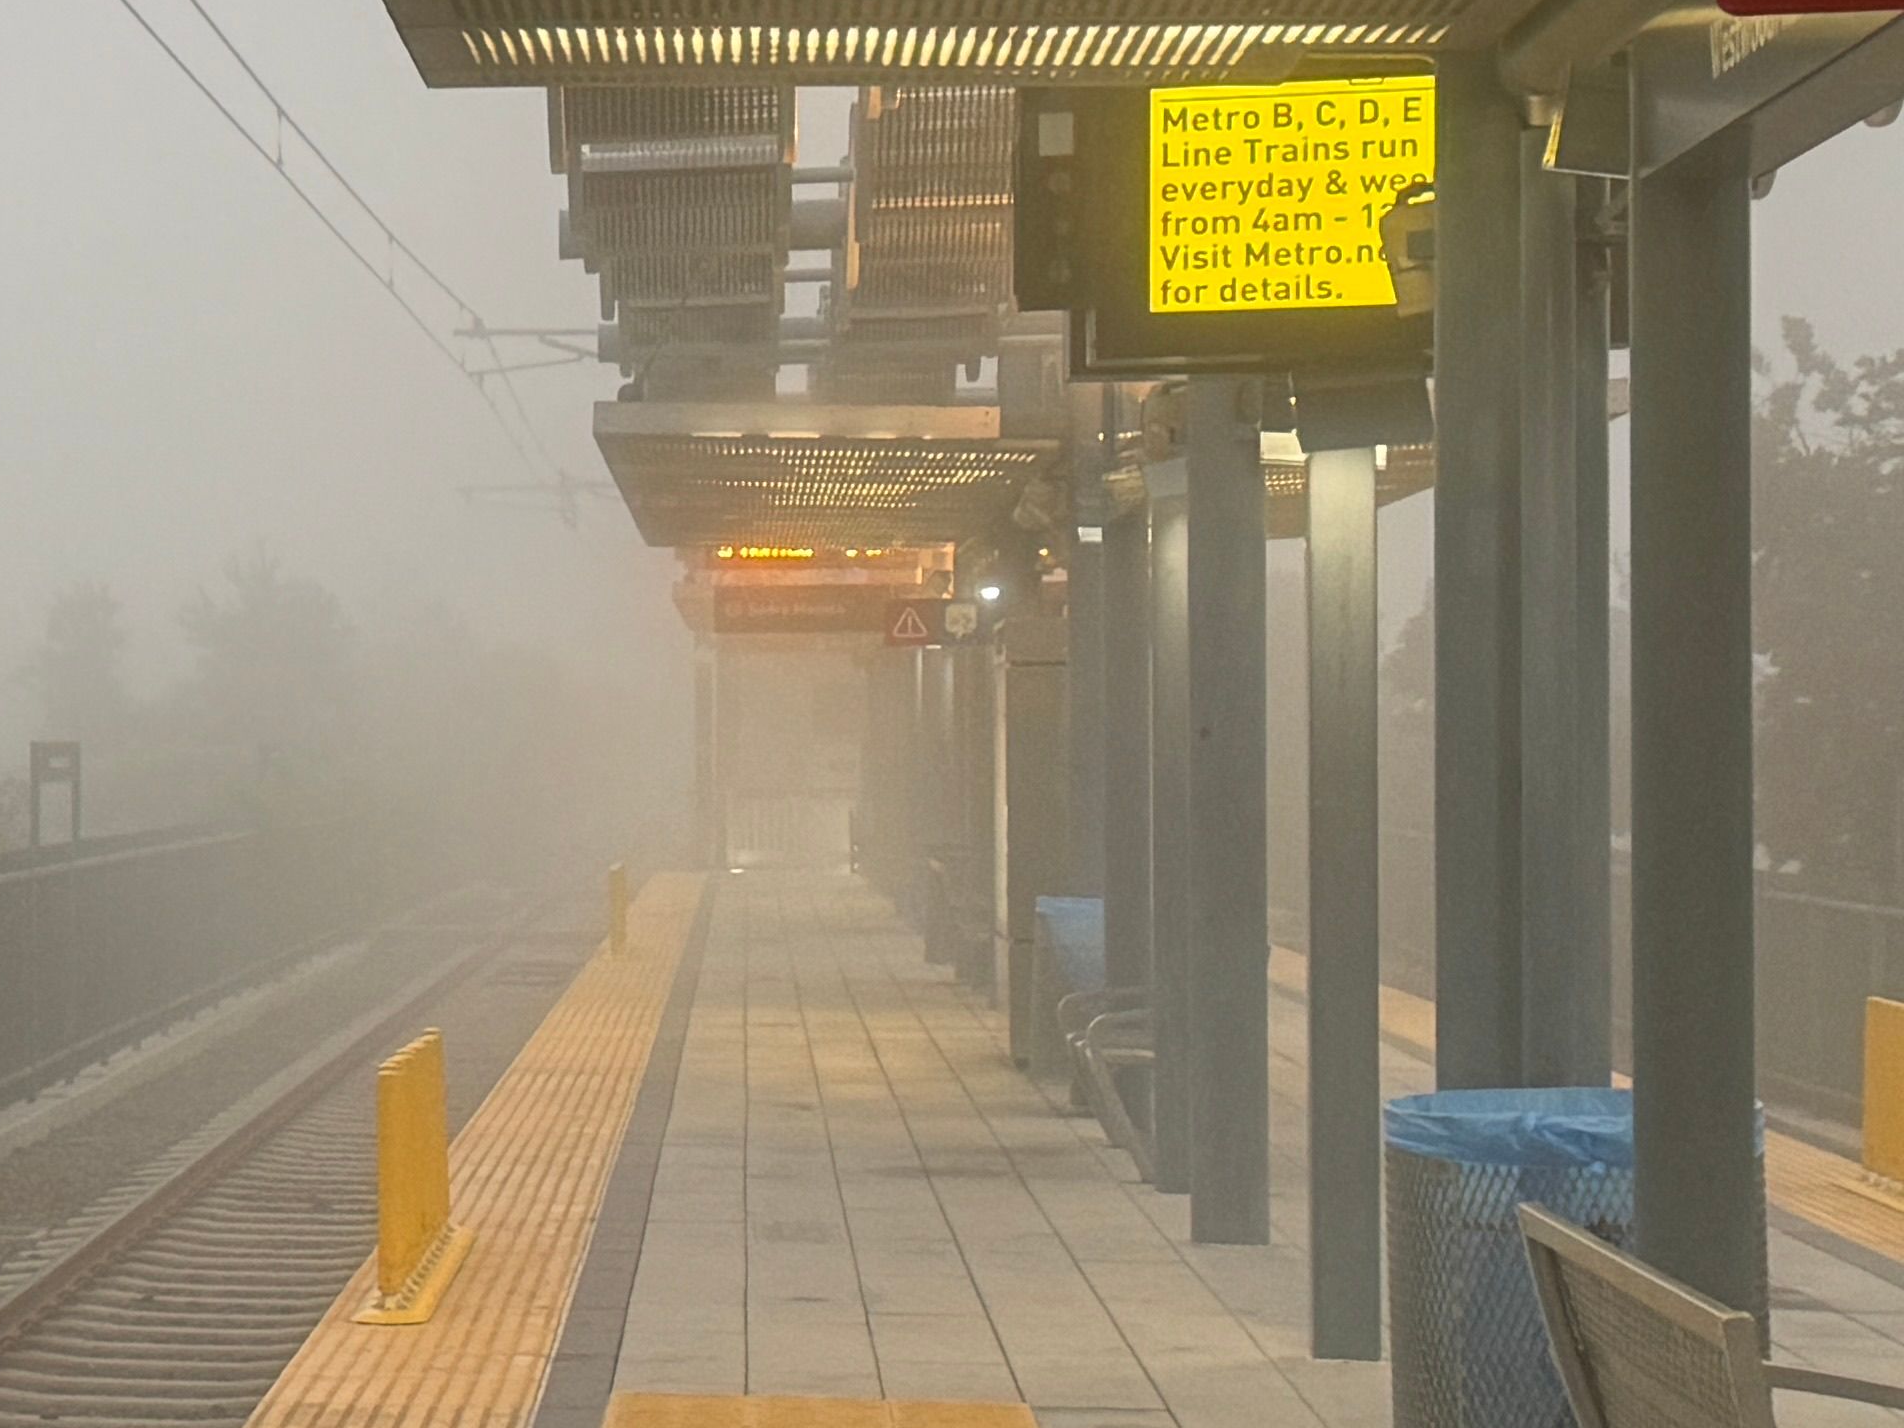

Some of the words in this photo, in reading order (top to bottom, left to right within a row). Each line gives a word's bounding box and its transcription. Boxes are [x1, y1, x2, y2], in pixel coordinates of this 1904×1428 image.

[1162, 107, 1261, 134] Metro
[1273, 102, 1304, 132] B,
[1316, 100, 1346, 130] C,
[1359, 98, 1390, 128] D,
[1403, 96, 1423, 123] E
[1161, 141, 1232, 168] Line
[1244, 136, 1350, 165] Trains
[1361, 137, 1419, 160] run
[1160, 172, 1314, 206] everyday
[1325, 169, 1349, 195] &
[1160, 210, 1241, 237] from
[1252, 207, 1323, 233] 4am
[1160, 243, 1232, 271] Visit
[1160, 279, 1209, 305] for
[1219, 273, 1343, 303] details.
